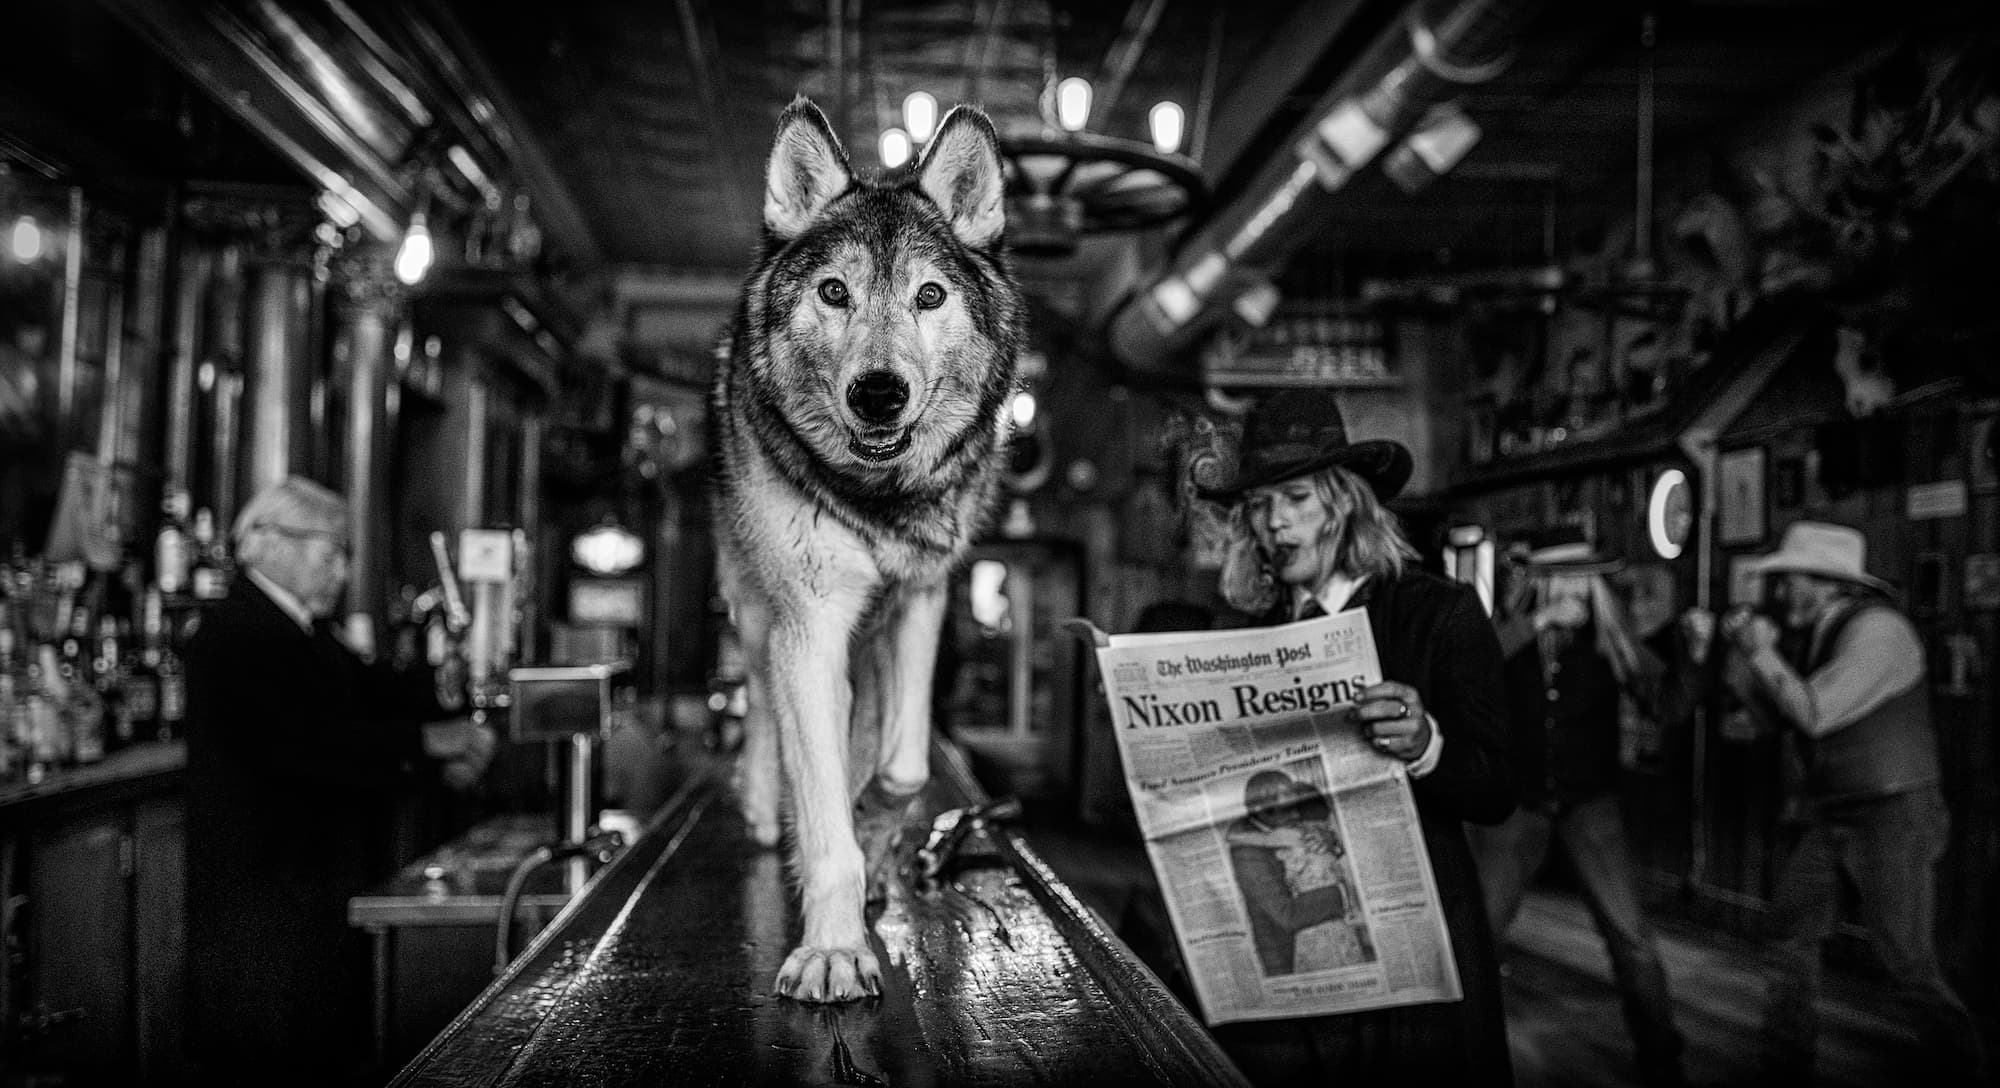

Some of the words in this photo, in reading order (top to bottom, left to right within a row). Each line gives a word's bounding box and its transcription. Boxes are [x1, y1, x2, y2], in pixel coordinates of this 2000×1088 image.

[1157, 659, 1183, 679] The
[1184, 653, 1273, 673] Washington
[1276, 642, 1312, 668] Post
[1122, 693, 1222, 730] Nixon
[1231, 675, 1366, 719] Resigns
